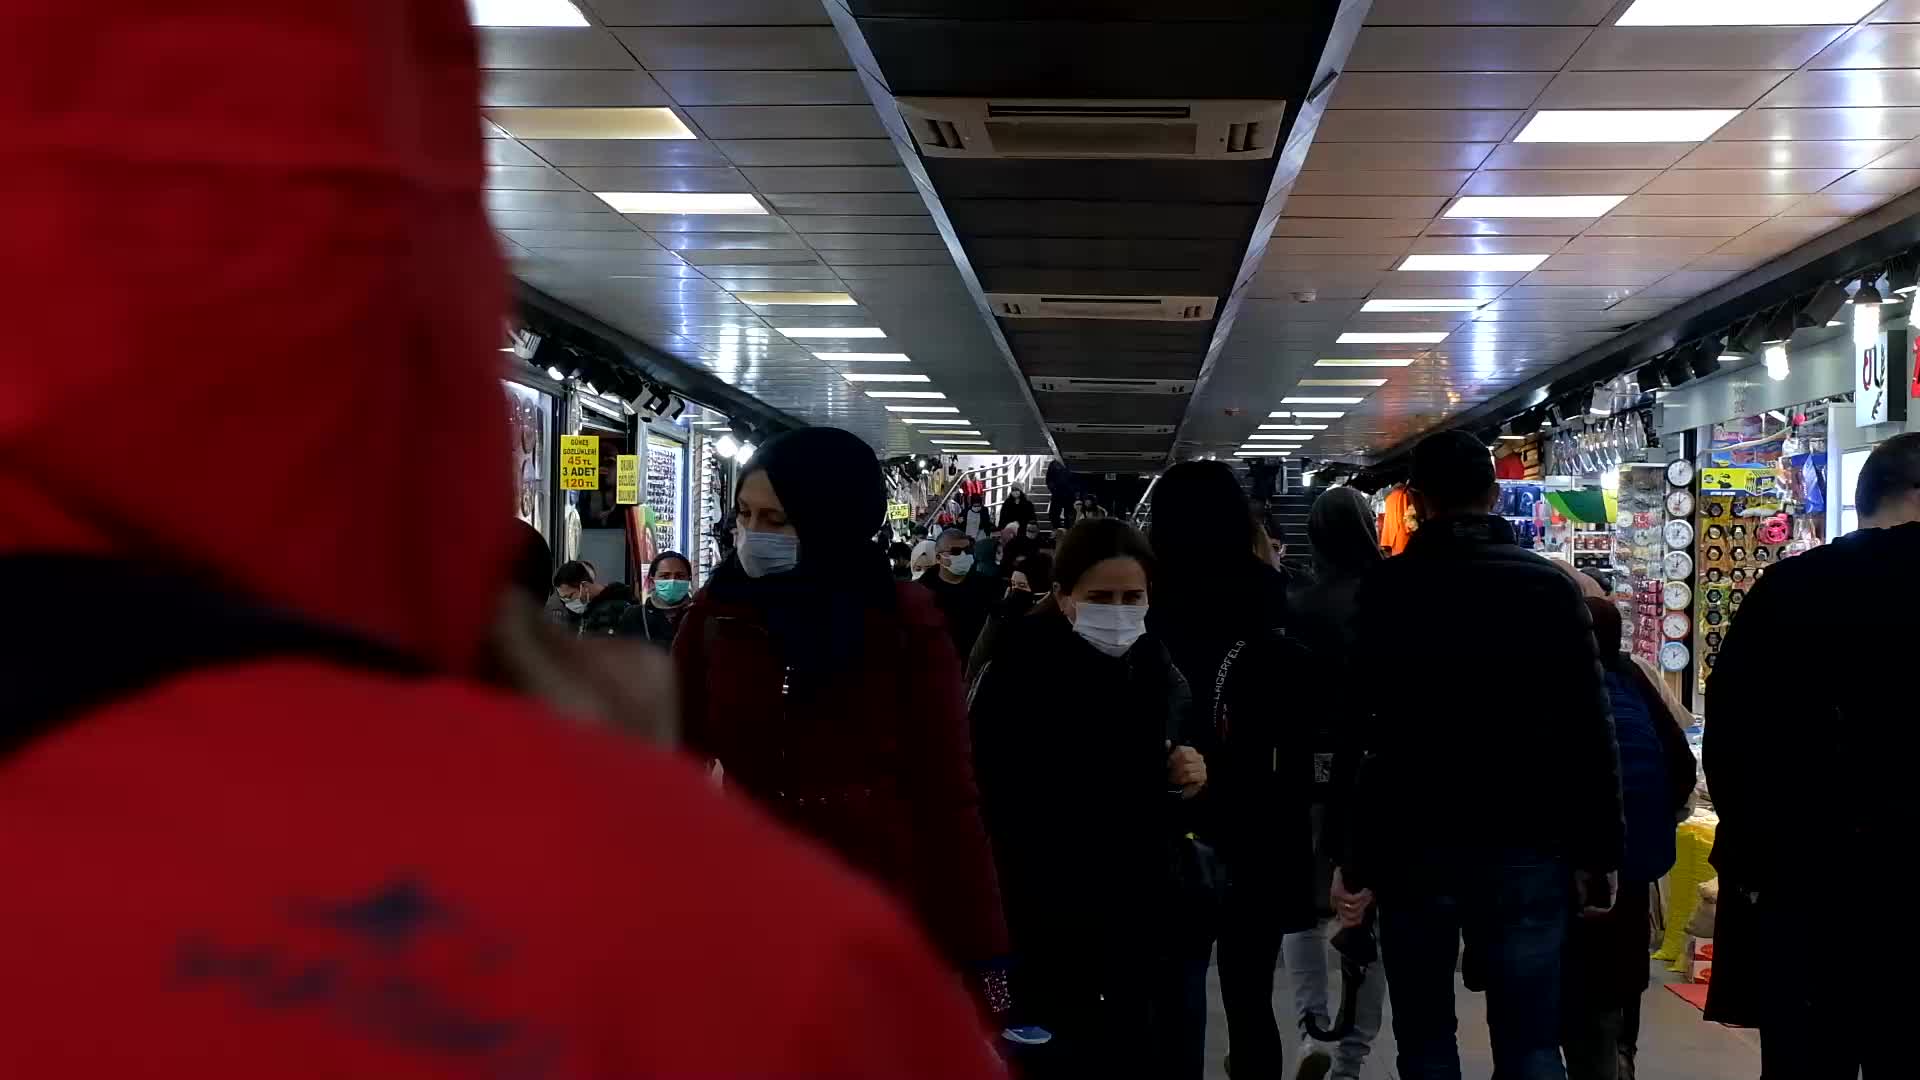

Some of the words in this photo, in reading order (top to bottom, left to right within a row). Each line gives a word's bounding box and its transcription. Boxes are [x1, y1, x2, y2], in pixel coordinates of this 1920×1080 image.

[567, 456, 582, 465] 45
[562, 467, 568, 476] 3
[571, 467, 596, 476] ADET
[566, 479, 584, 488] 120
